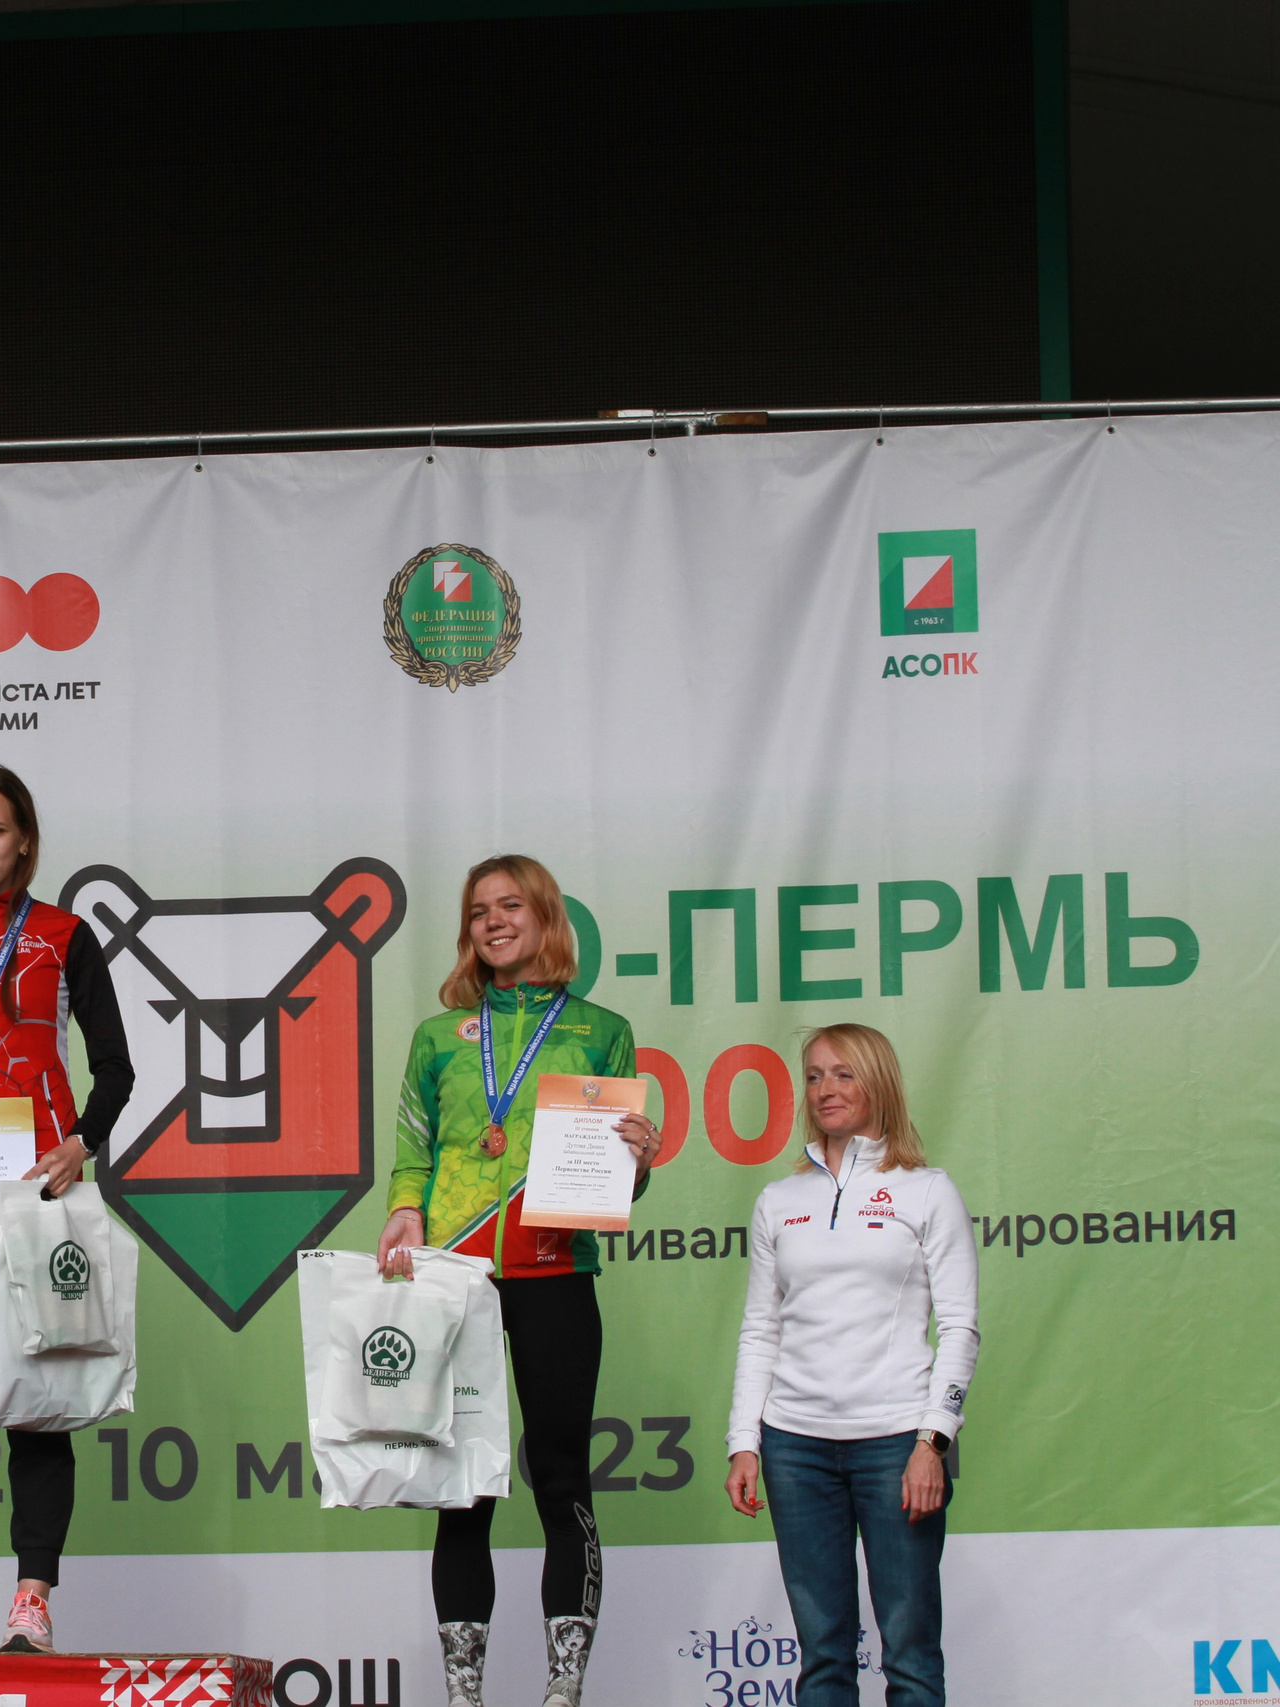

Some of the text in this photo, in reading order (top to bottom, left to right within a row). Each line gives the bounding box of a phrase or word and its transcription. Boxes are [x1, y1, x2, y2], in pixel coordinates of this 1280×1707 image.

[411, 609, 496, 623] ФЕДЕРАЦИЯ
[921, 617, 938, 625] 1963
[424, 625, 485, 636] спортивного
[415, 634, 493, 644] ориентирования
[424, 646, 483, 659] РОССИИ
[882, 652, 979, 678] АСОПК
[54, 681, 101, 701] ЛЕТ
[784, 1215, 810, 1226] PERM
[598, 1209, 1235, 1262] тивал ирования
[52, 1283, 89, 1292] МЕДВЕЖИЙ
[61, 1291, 83, 1300] КЛЮЧ
[363, 1368, 410, 1379] МЕДВЕЖИЙ
[371, 1378, 398, 1387] КЛЮЧ
[454, 1387, 479, 1396] РМЬ
[384, 1441, 419, 1450] ПЕРМЬ
[98, 1426, 199, 1502] 10
[705, 1670, 797, 1707] Зем
